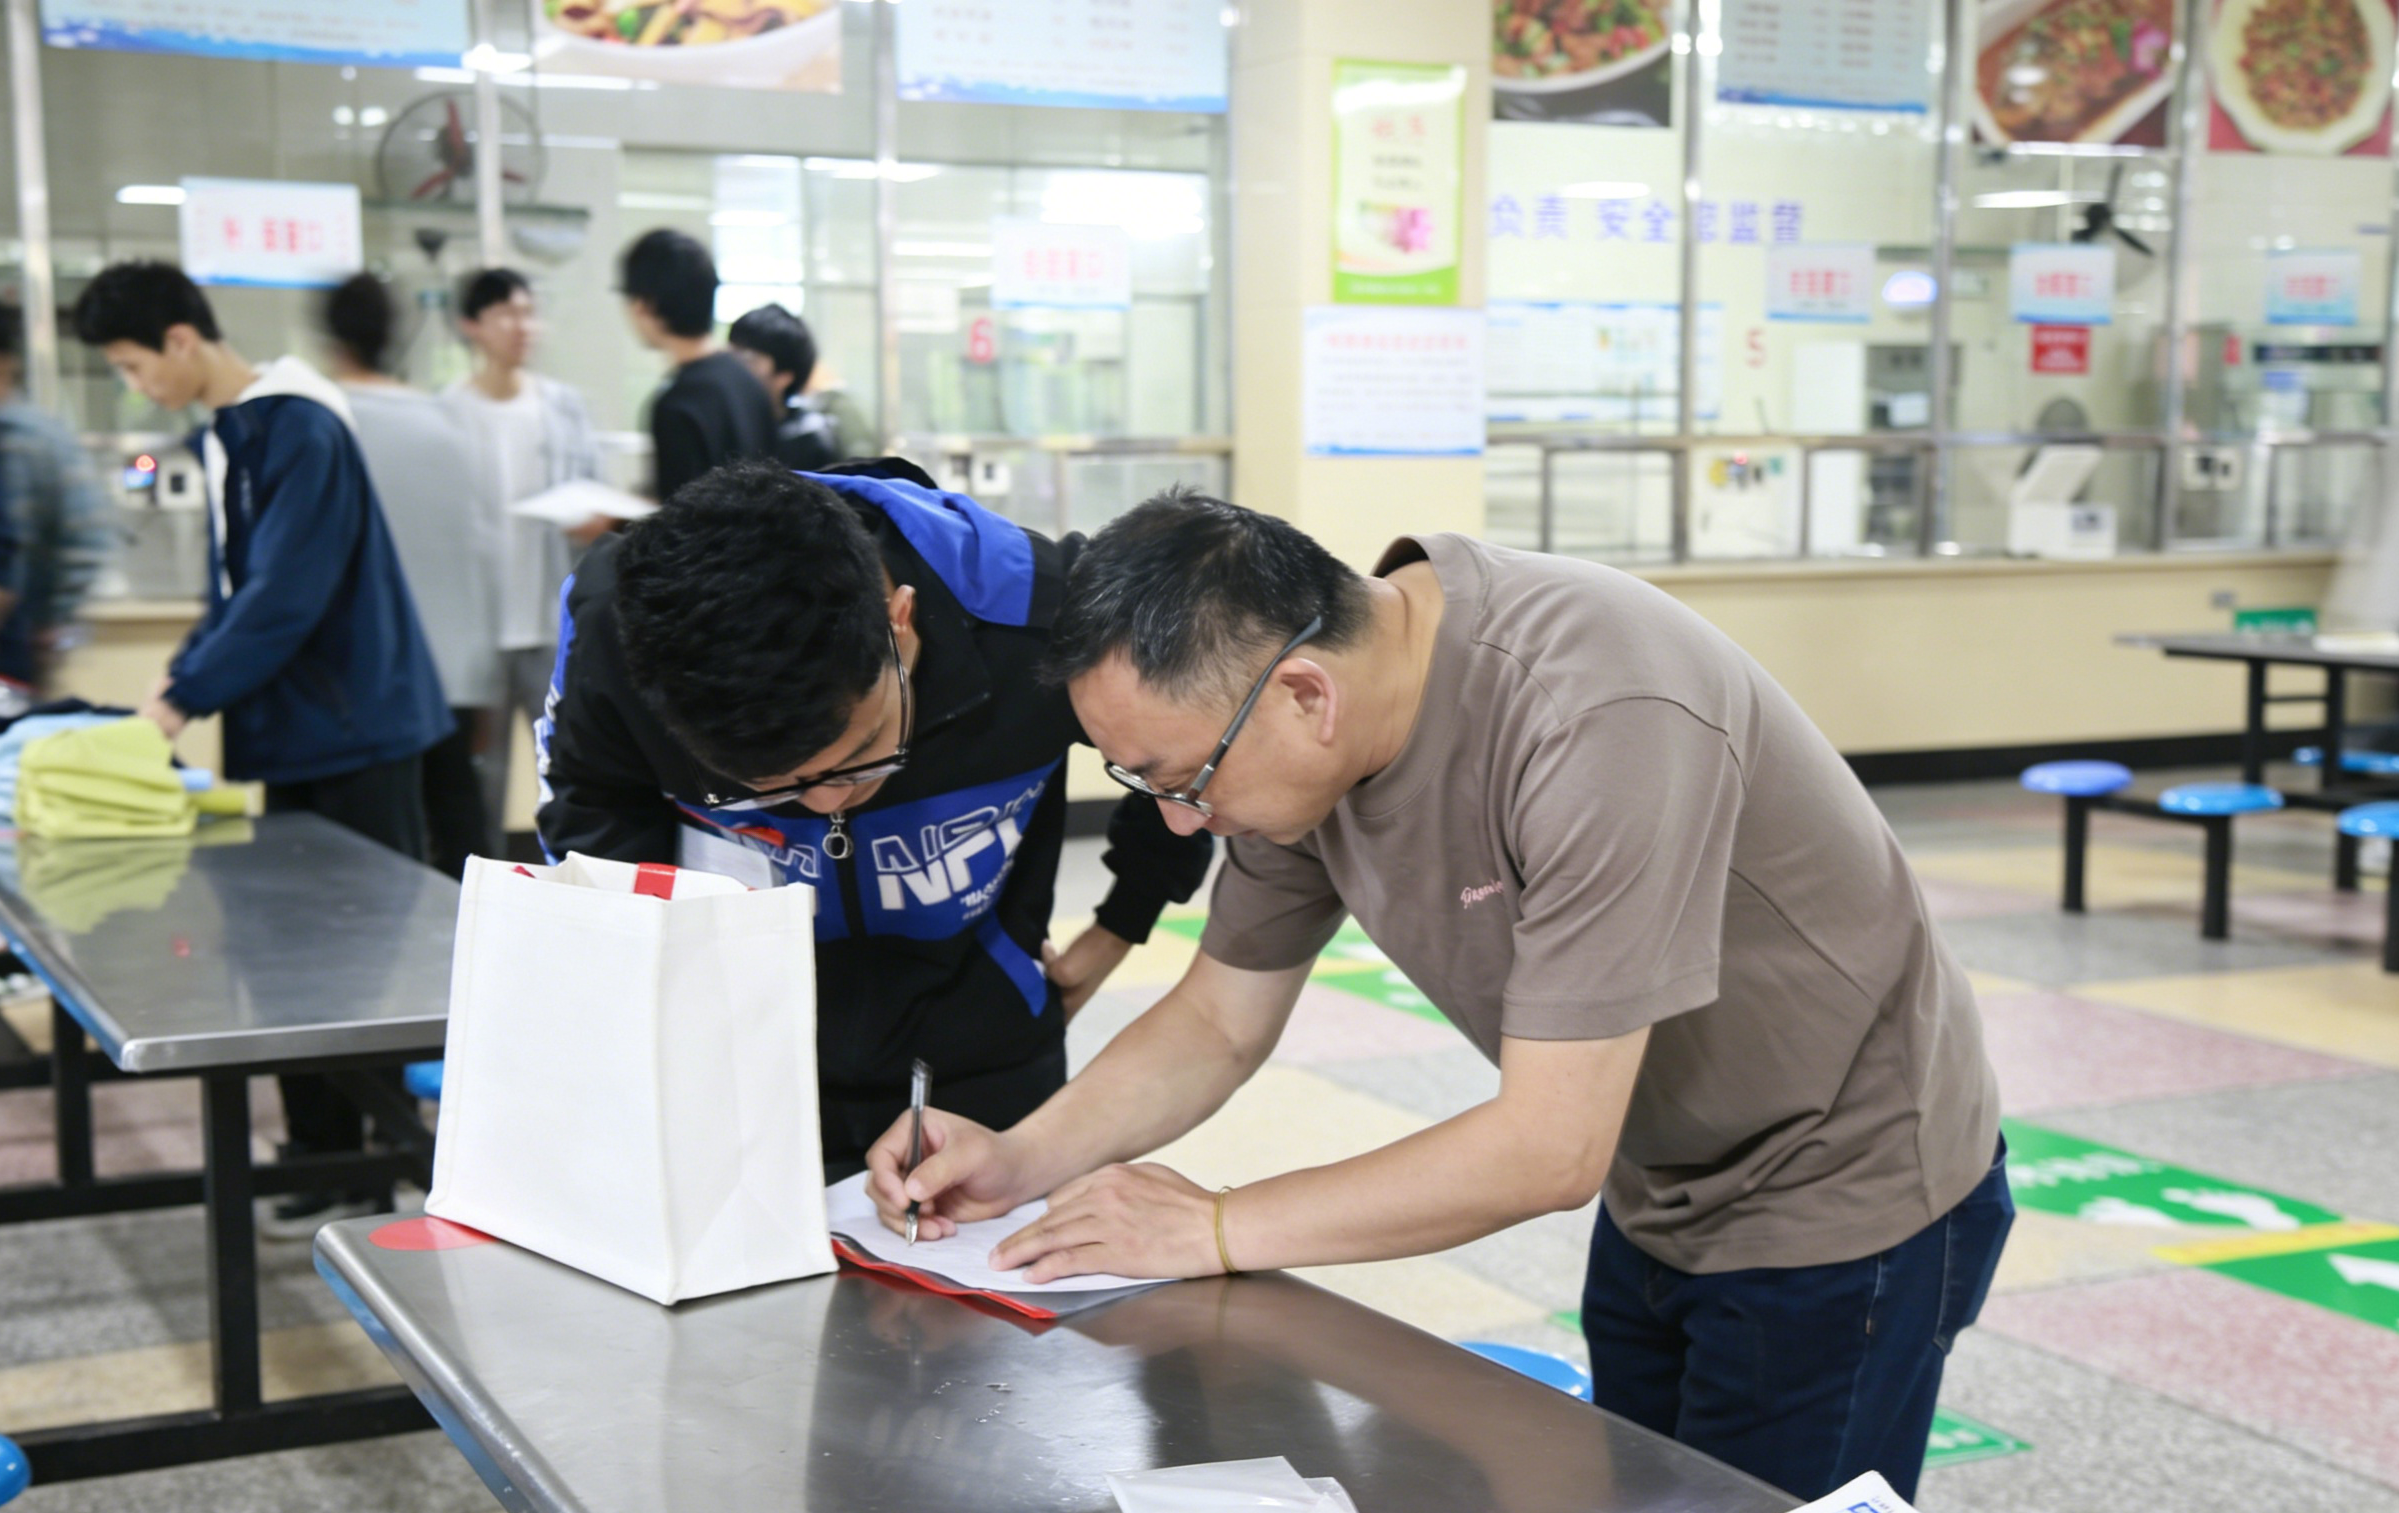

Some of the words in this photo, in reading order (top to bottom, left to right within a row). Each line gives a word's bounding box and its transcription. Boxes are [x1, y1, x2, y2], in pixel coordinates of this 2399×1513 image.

[1488, 193, 1568, 241] 负责
[968, 317, 996, 365] 6
[1746, 328, 1766, 367] 5
